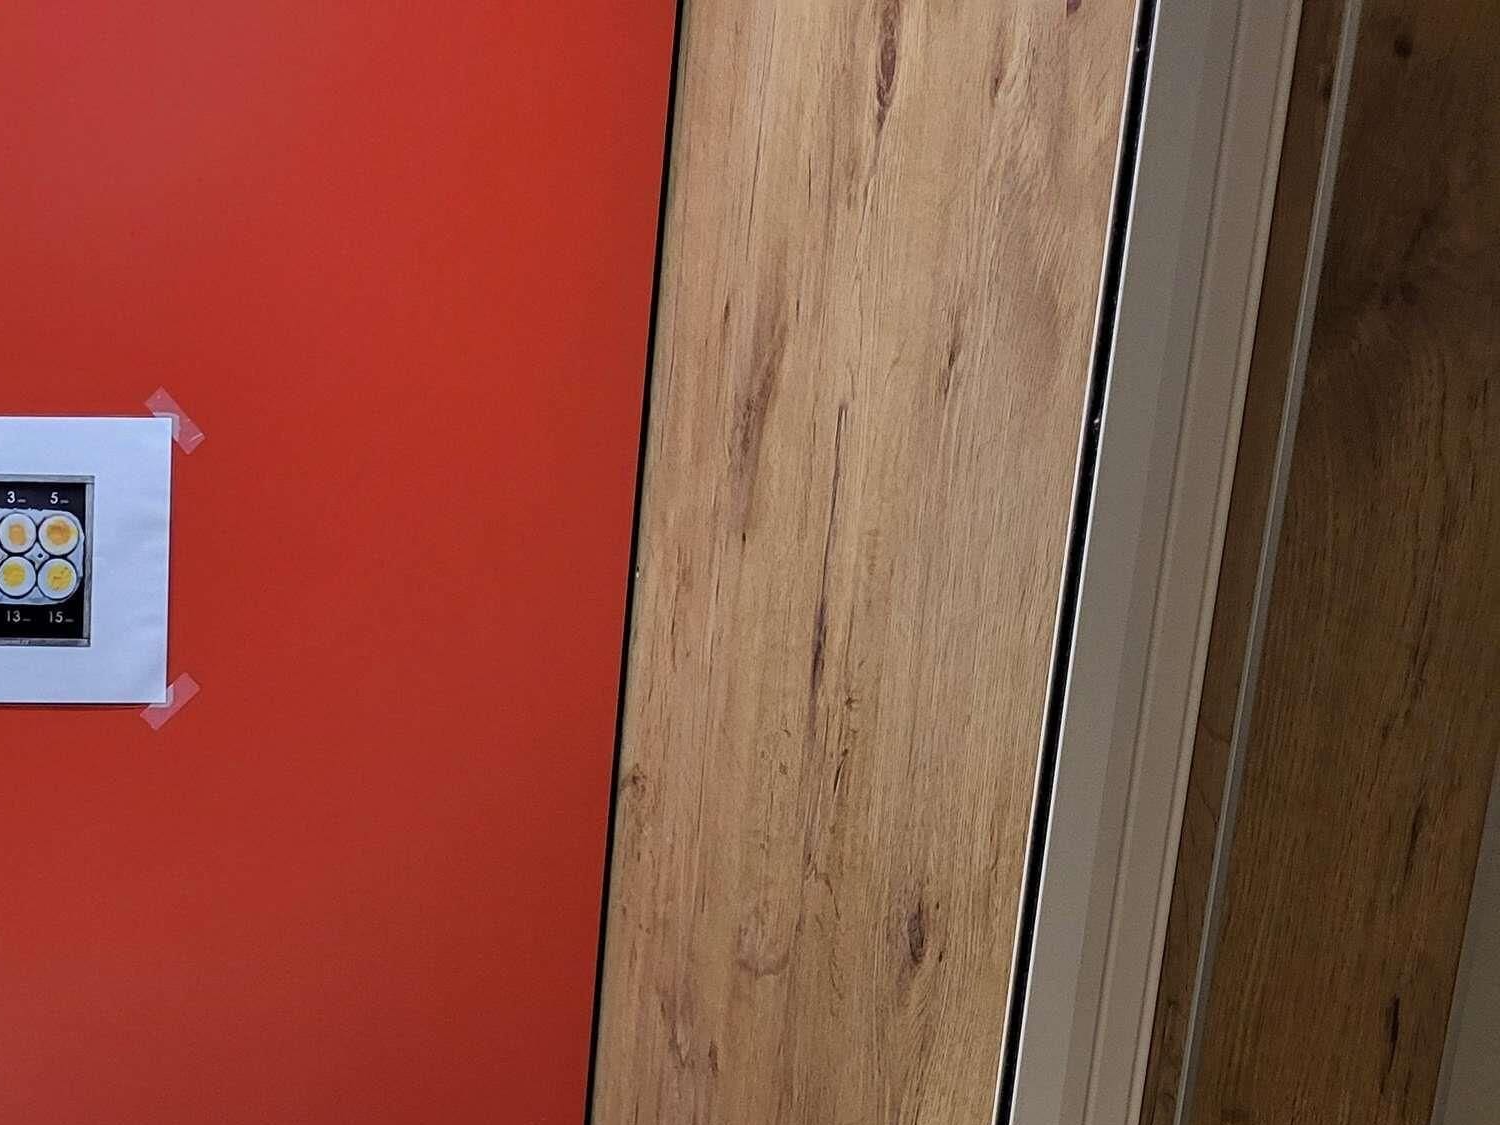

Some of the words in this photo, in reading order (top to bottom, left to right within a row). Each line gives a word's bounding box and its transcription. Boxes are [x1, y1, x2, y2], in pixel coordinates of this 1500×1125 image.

[7, 490, 16, 504] 3
[50, 491, 59, 504] 5
[6, 610, 21, 623] 13
[49, 611, 64, 623] 15
